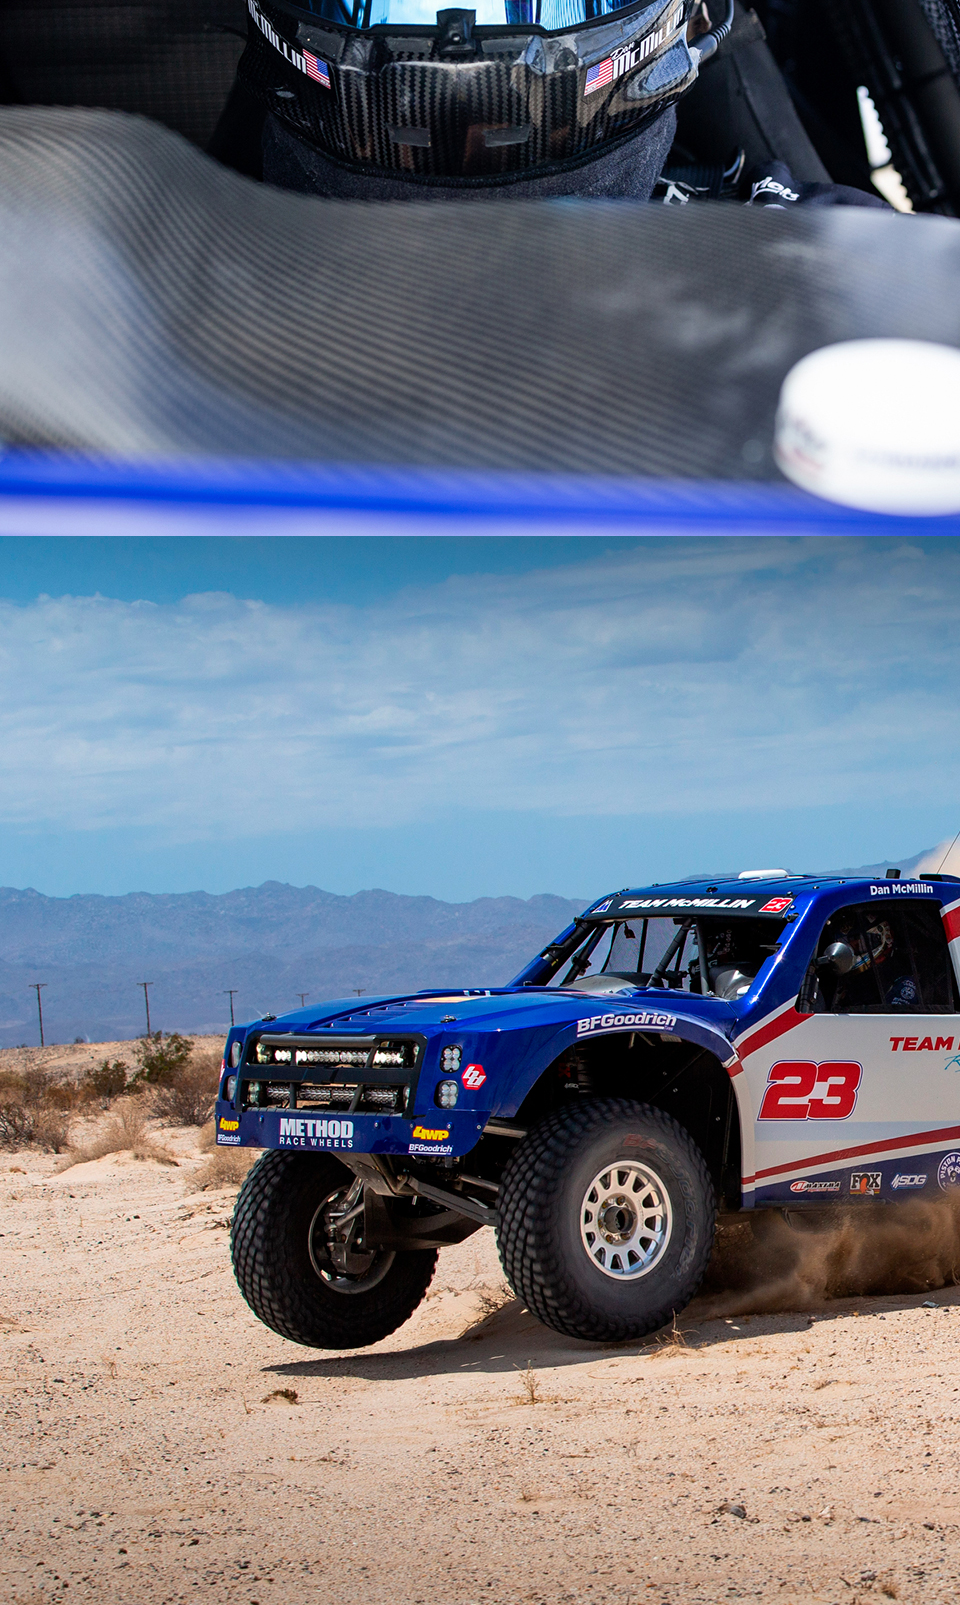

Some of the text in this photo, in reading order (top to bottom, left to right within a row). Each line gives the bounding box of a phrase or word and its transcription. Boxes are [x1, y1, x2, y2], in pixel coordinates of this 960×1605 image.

[870, 883, 934, 896] Dan McMillin
[617, 898, 664, 910] TEAM
[760, 898, 793, 912] 23
[577, 1011, 677, 1033] BFGoodrich
[889, 1035, 954, 1052] TEAM
[759, 1061, 862, 1121] 23
[219, 1117, 240, 1132] 4WP
[279, 1117, 354, 1139] METHOD
[412, 1125, 450, 1141] 4WP
[279, 1136, 354, 1148] RACE WHEELS
[409, 1143, 453, 1153] BFGoodrich
[851, 1174, 881, 1190] FOX
